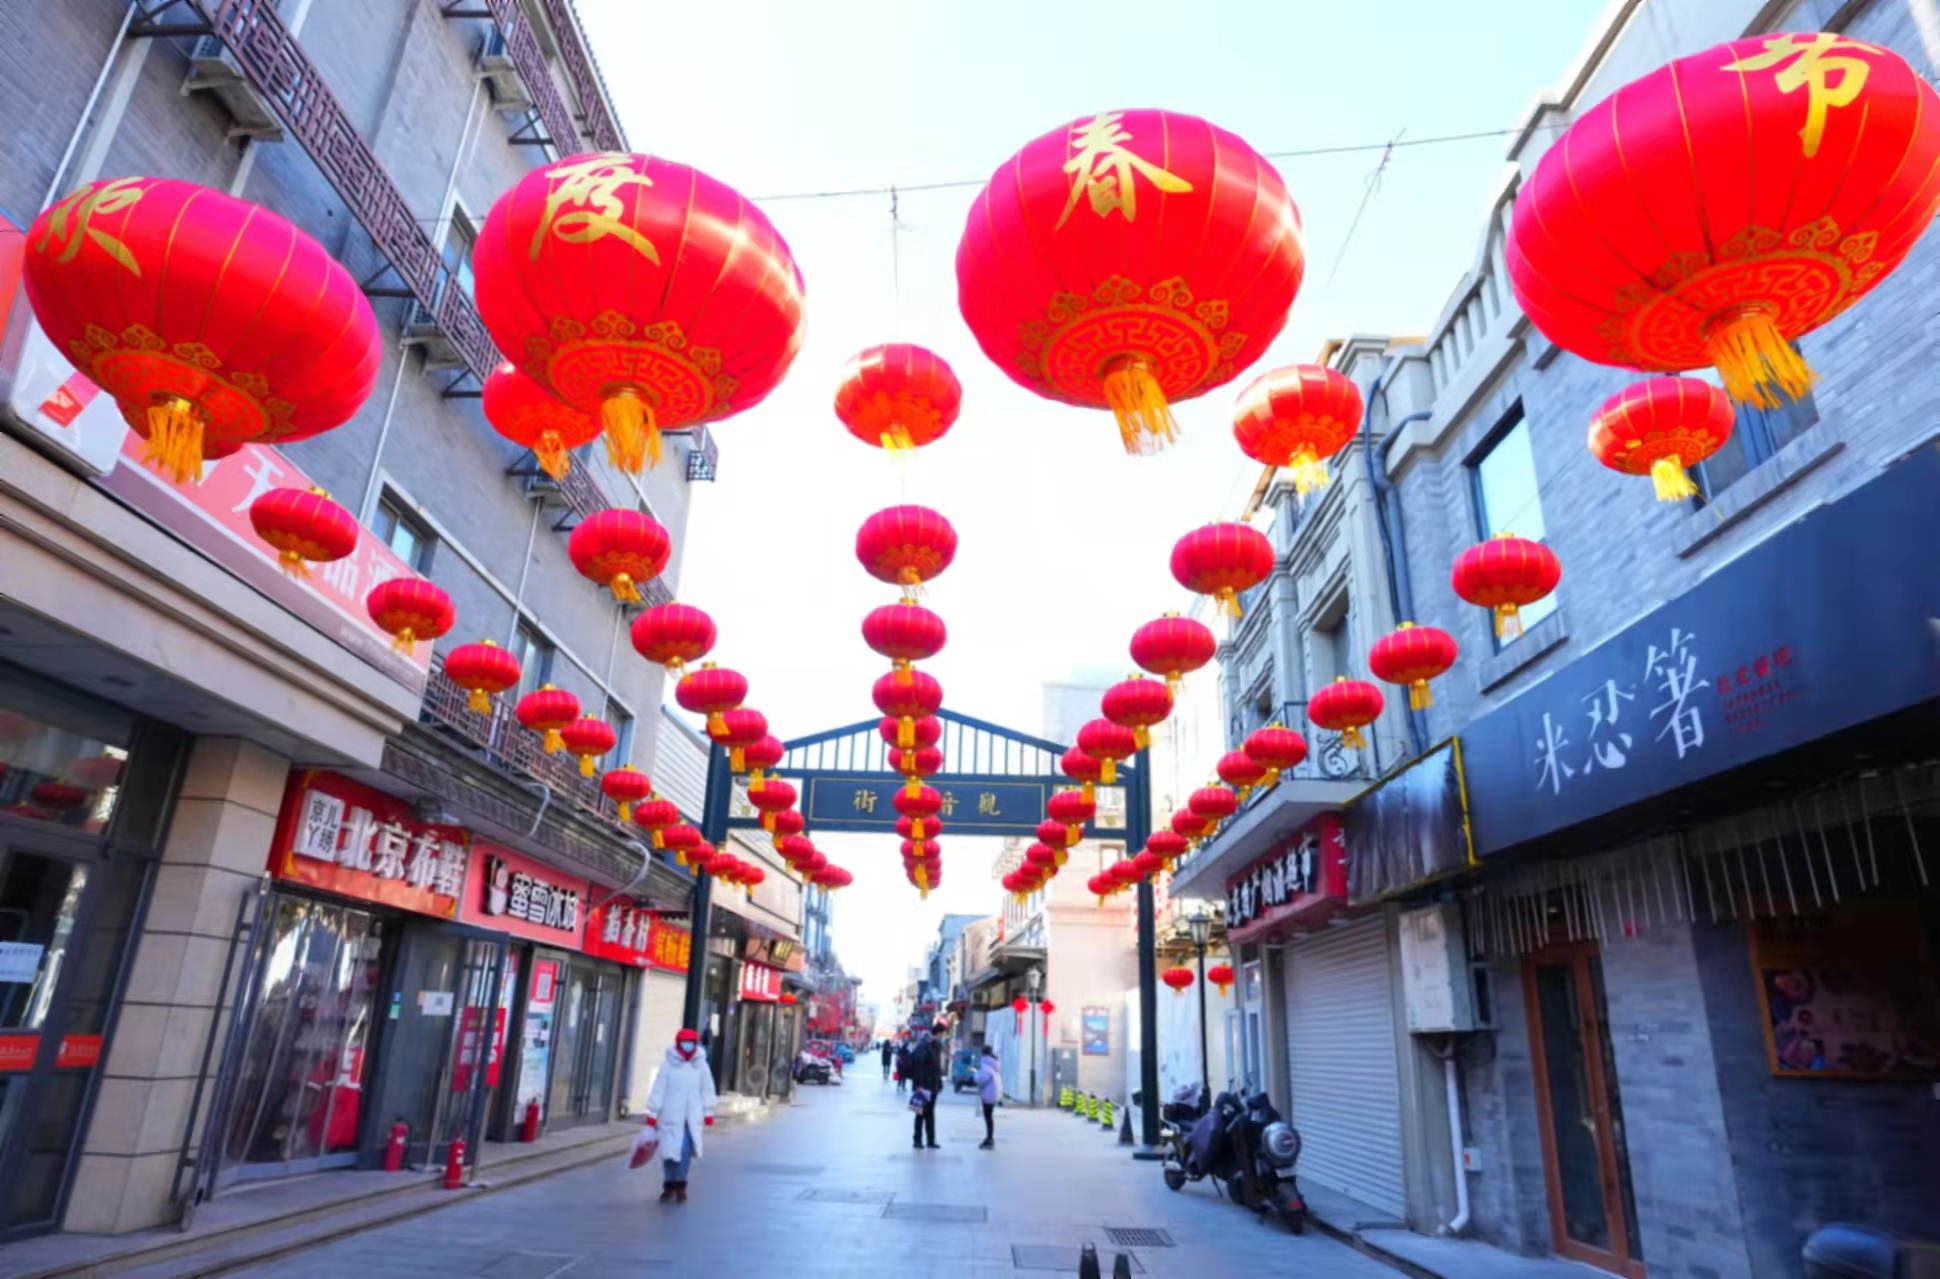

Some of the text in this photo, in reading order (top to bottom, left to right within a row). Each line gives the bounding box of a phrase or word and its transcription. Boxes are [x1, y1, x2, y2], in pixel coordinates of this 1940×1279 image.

[529, 153, 662, 267] 度
[1055, 111, 1193, 223] 春
[337, 806, 467, 898] 北京布鞋
